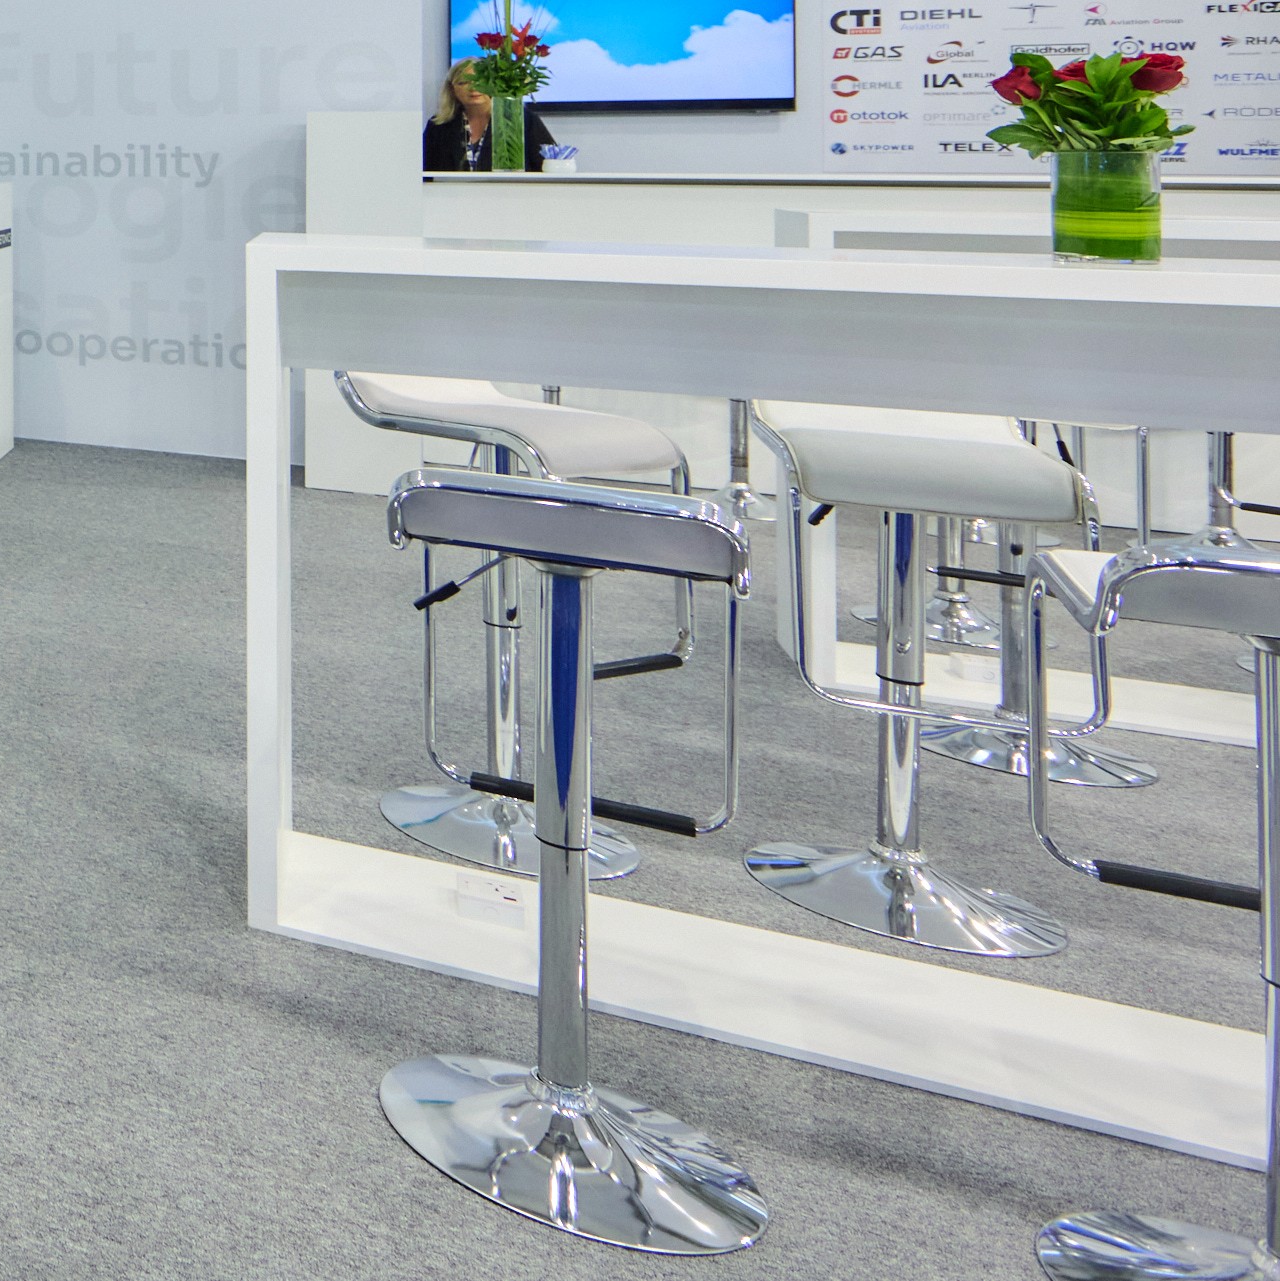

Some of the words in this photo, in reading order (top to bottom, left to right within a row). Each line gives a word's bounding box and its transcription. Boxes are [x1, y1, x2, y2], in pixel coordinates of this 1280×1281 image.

[900, 8, 983, 21] DIEHL
[900, 22, 950, 31] Aviation
[1014, 45, 1087, 55] Goldhofer
[1151, 41, 1196, 52] HQW
[853, 46, 905, 59] GAS
[936, 50, 975, 59] Global
[852, 81, 903, 90] HERMLE
[924, 73, 963, 88] ILA
